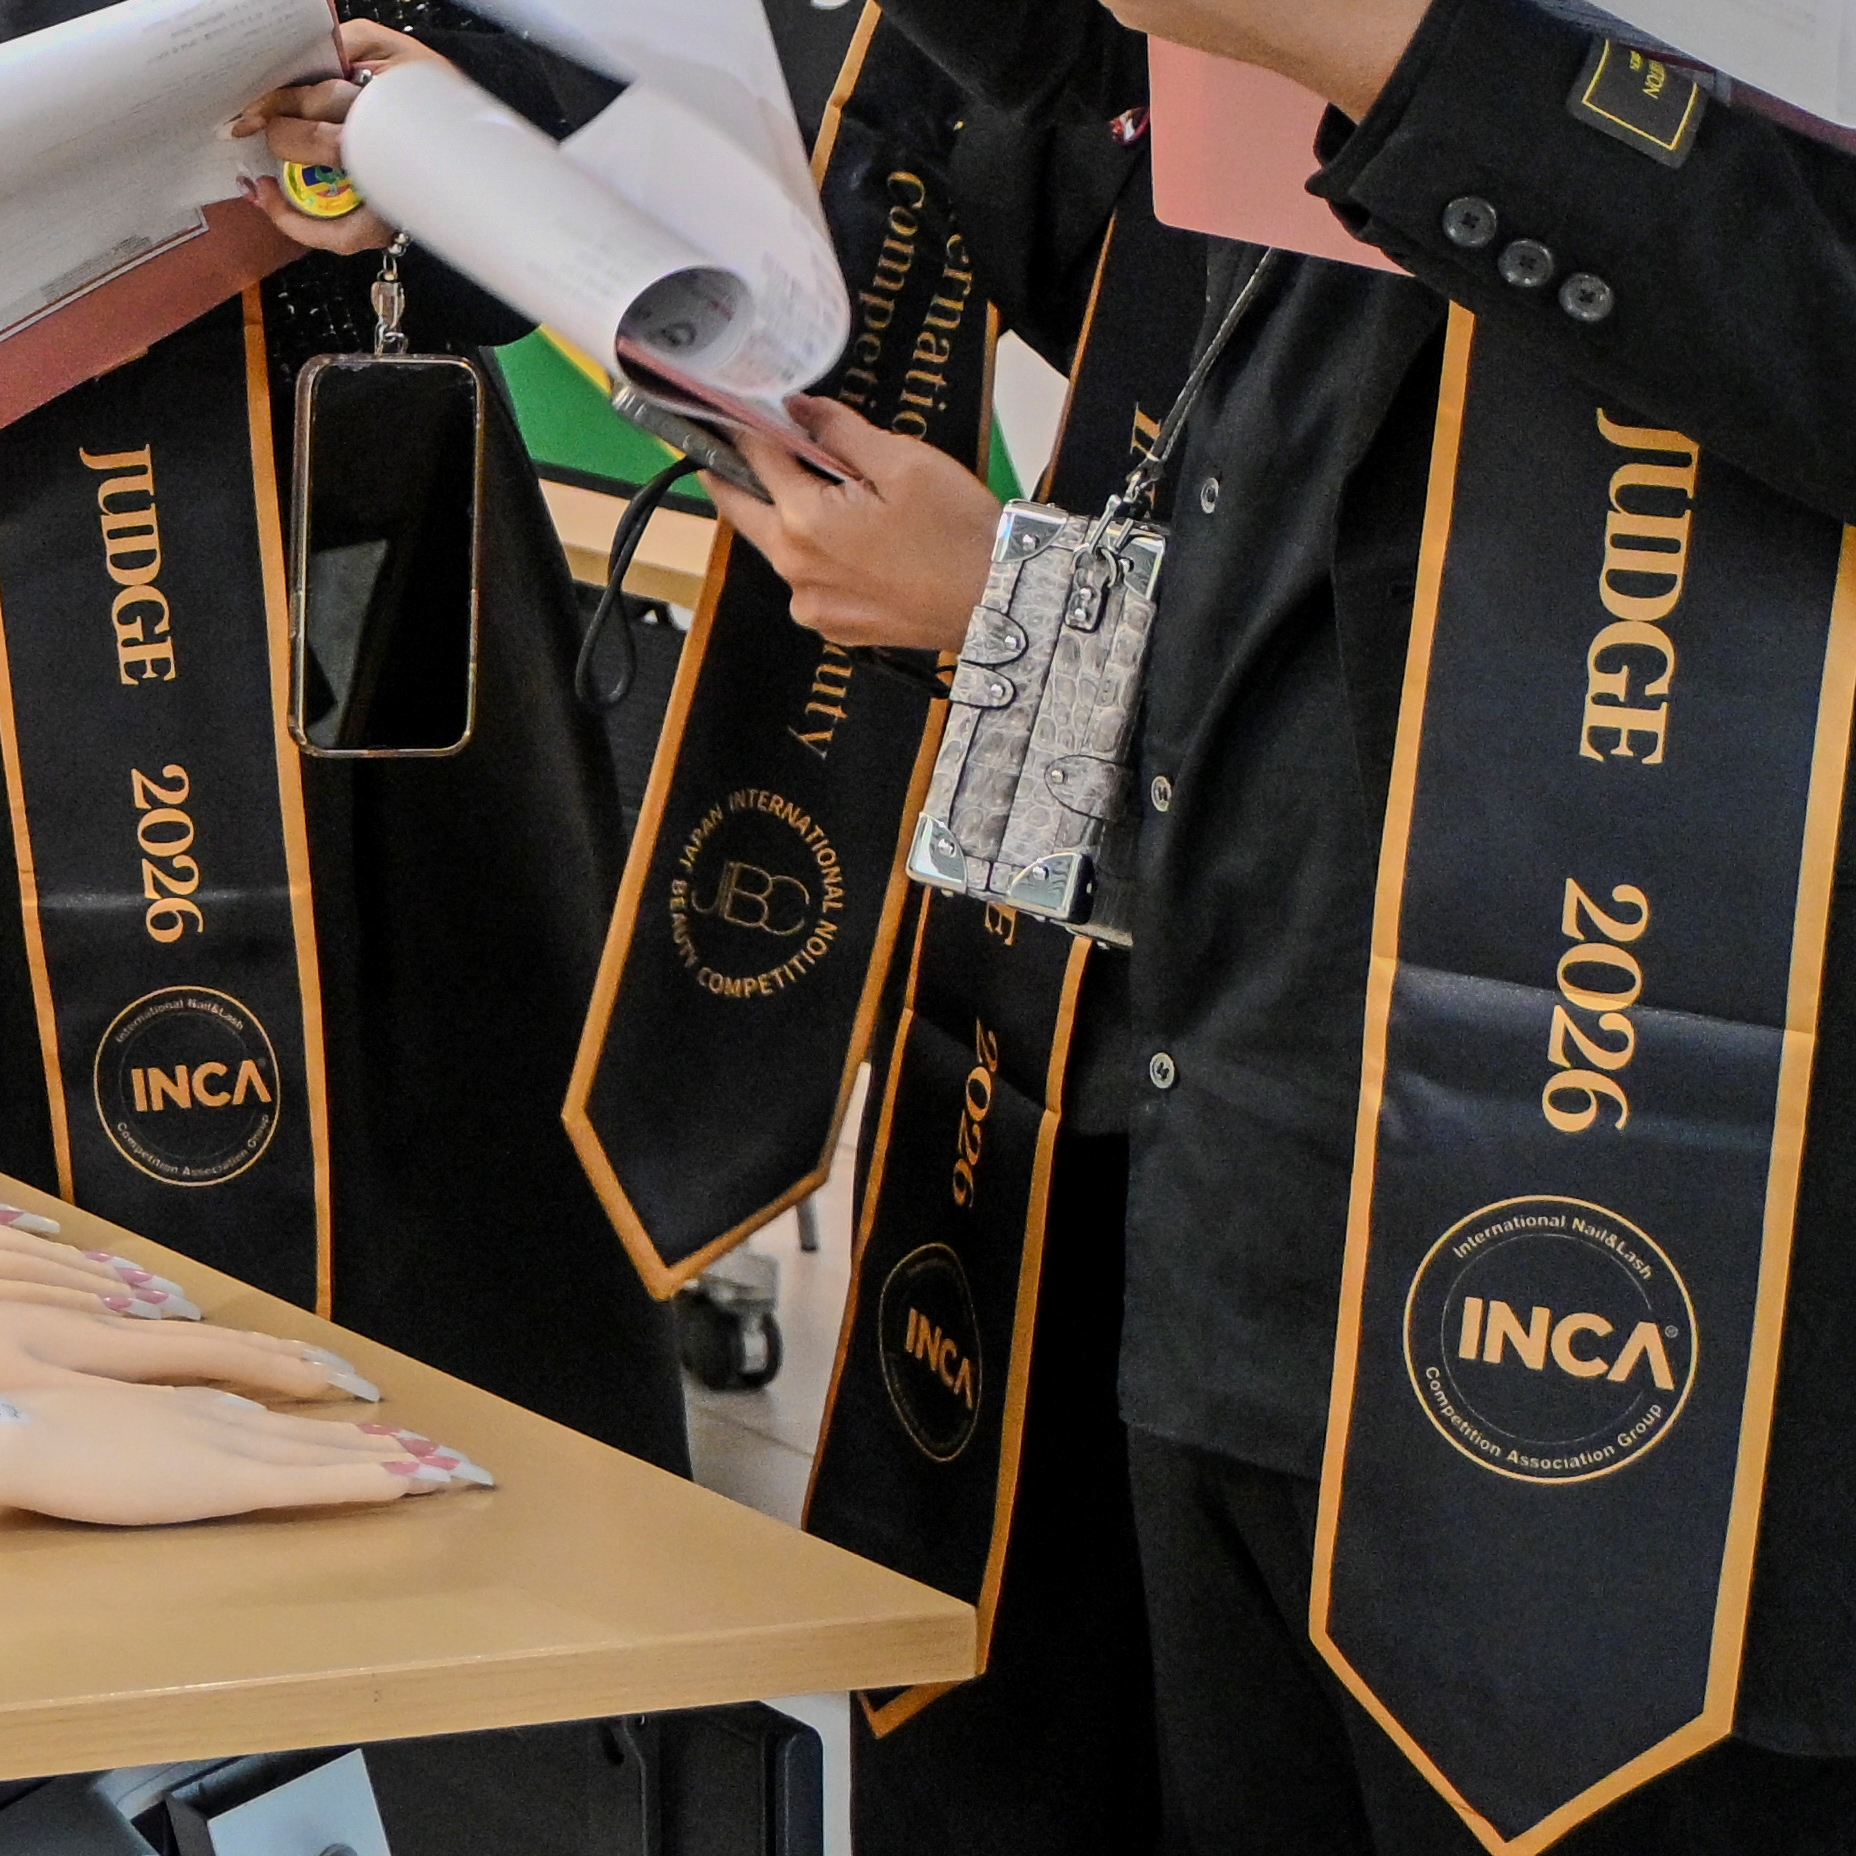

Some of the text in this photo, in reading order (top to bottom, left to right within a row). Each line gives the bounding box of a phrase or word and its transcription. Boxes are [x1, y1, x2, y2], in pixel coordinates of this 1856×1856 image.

[78, 442, 205, 944] JUDGE 2026
[787, 643, 854, 761] uty
[1541, 407, 1700, 1134] JUDGE 2026
[728, 788, 845, 914] INTERNATIONAL
[696, 918, 839, 998] COMPETITION
[130, 1058, 273, 1113] INCA
[952, 1016, 999, 1209] 2026
[1452, 1214, 1654, 1281] International Nail&Lash
[904, 1306, 974, 1411] INCA
[1458, 1295, 1676, 1391] INCA
[1425, 1366, 1663, 1470] Competition Association Group
